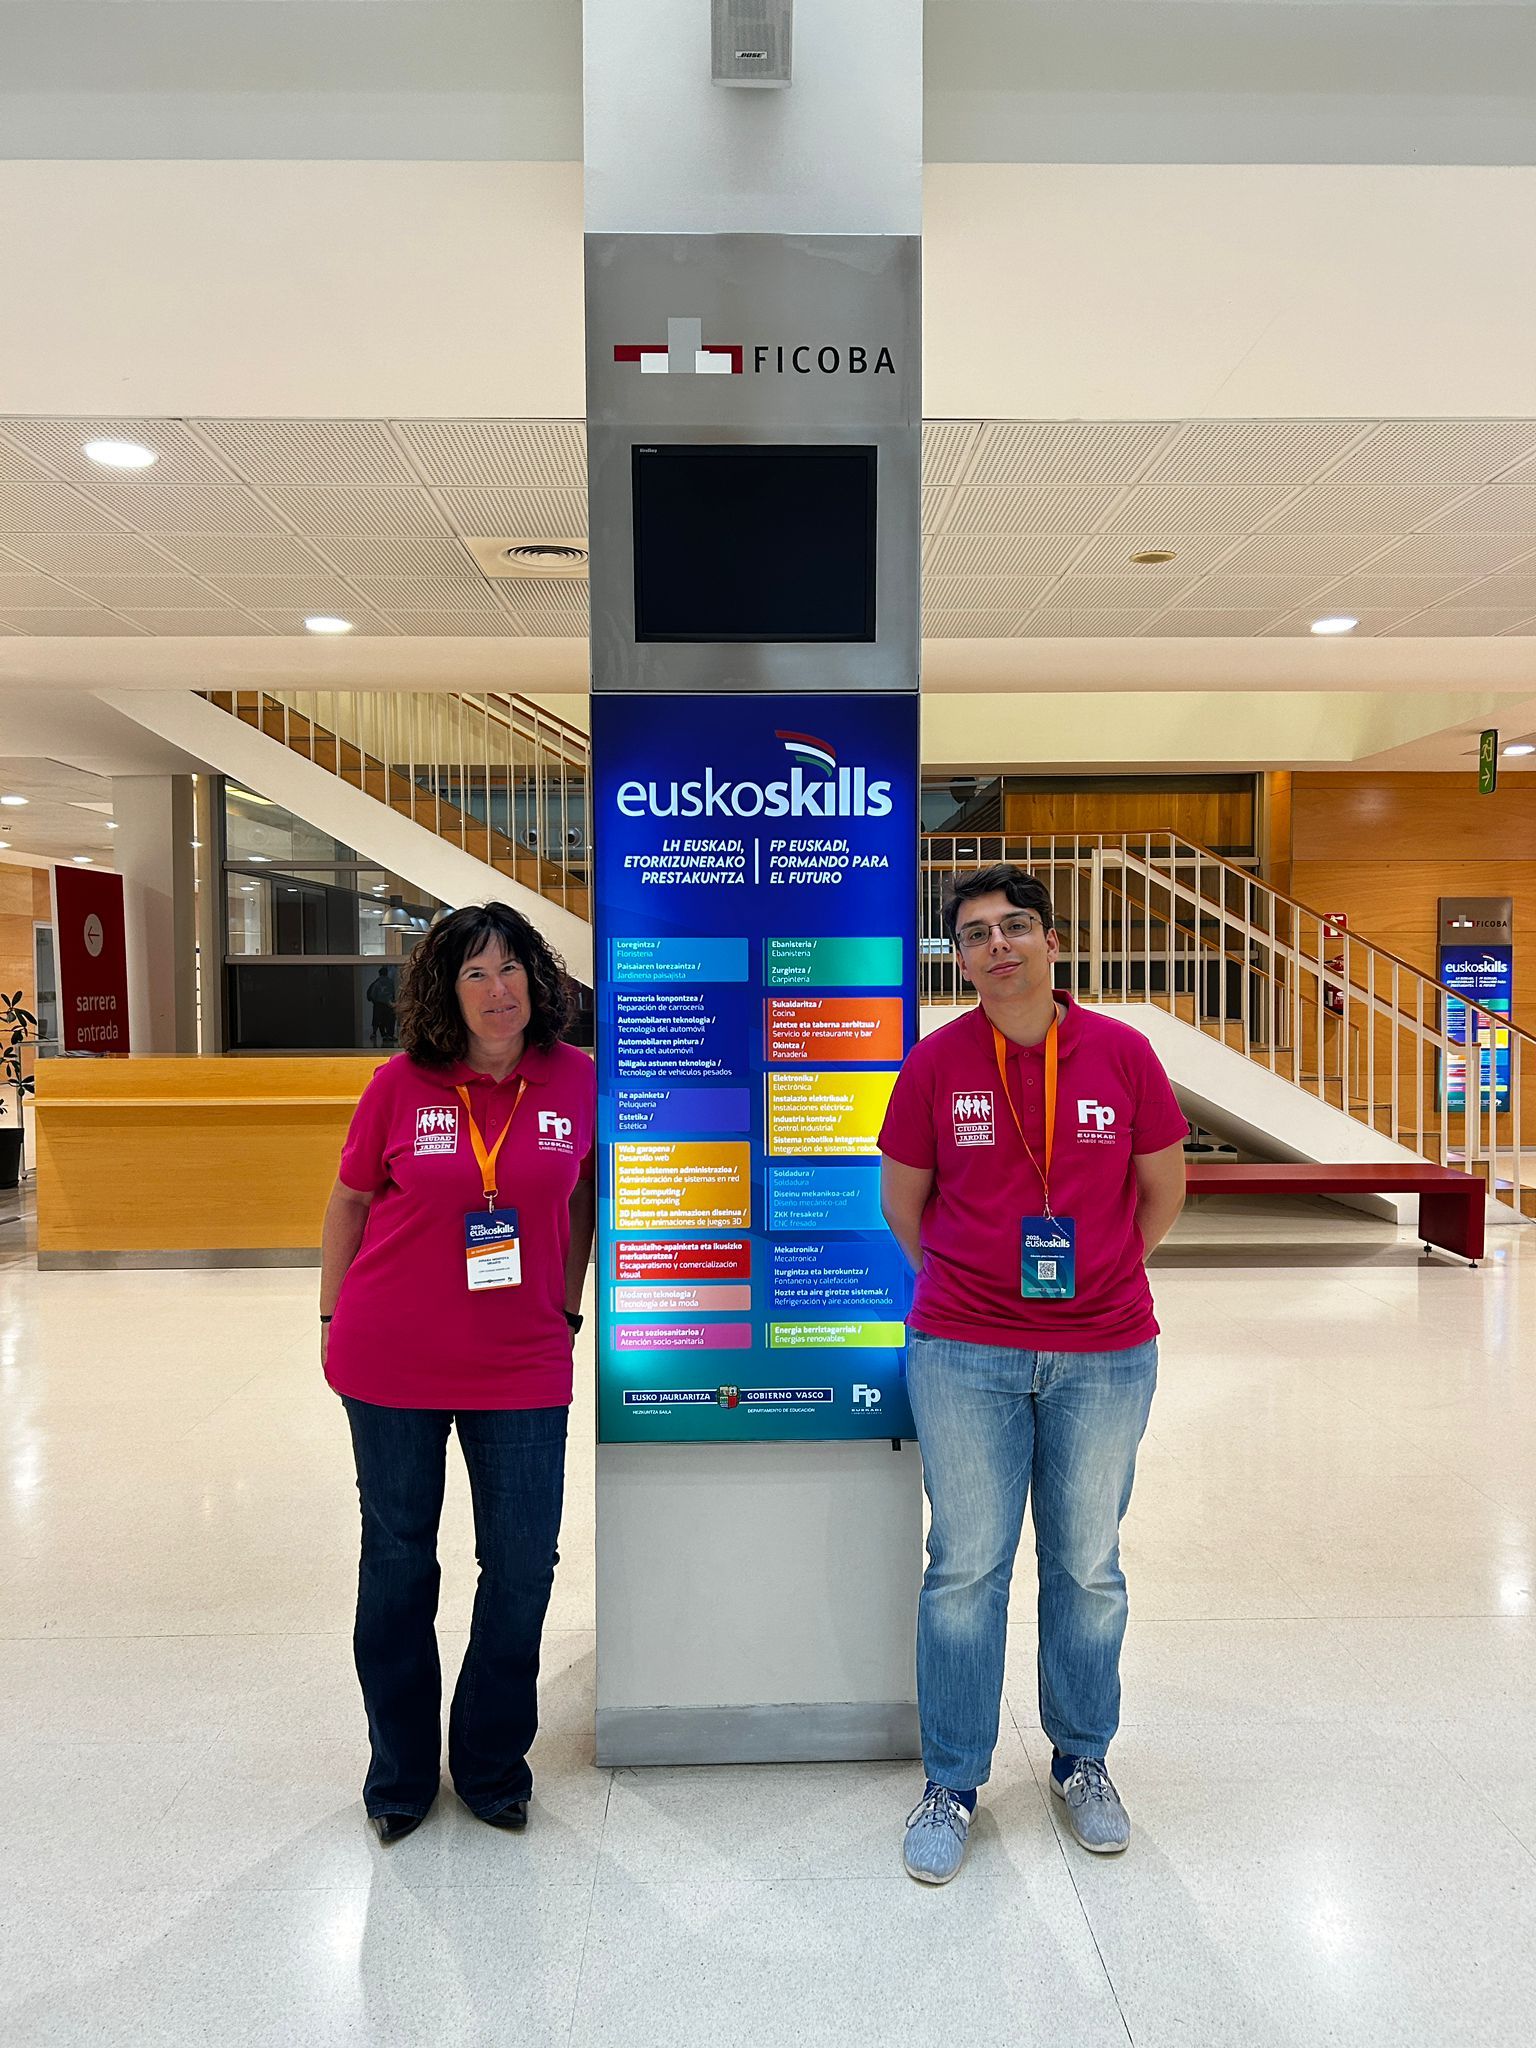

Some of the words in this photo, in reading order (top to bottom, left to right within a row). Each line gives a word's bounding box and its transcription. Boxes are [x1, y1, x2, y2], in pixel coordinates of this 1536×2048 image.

[754, 346, 896, 374] FICOBA
[616, 767, 892, 817] euskoskills
[663, 840, 680, 852] LH
[683, 840, 744, 854] EUSKADI,
[770, 840, 786, 852] FP
[789, 840, 850, 854] EUSKADI,
[624, 856, 745, 868] ETORKIZUNERAKO
[770, 856, 849, 868] FORMANDO
[852, 856, 888, 868] PARA
[642, 872, 745, 884] PRESTAKUNTZA
[770, 872, 785, 884] EL
[788, 872, 842, 884] FUTURO
[1445, 961, 1508, 972] euskoskills
[77, 994, 116, 1012] sarrera
[656, 995, 698, 1003] konpontzea
[618, 1004, 656, 1012] Reparación
[673, 1016, 710, 1025] teknologia
[77, 1019, 118, 1042] entrada
[673, 1038, 699, 1046] pintura
[679, 1060, 716, 1068] teknologia
[629, 1092, 664, 1100] apainketa
[1077, 1100, 1115, 1130] Fp
[538, 1111, 572, 1139] Fp
[538, 1141, 573, 1149] EUSKADI
[774, 1145, 812, 1154] Integración
[641, 1197, 680, 1206] Computing
[707, 1218, 730, 1226] juegos
[470, 1224, 514, 1237] euskoskills
[1025, 1238, 1070, 1247] euskoskills
[774, 1269, 808, 1277] Iturgintza
[654, 1291, 691, 1299] teknologia
[824, 1289, 849, 1297] girotze
[774, 1298, 820, 1306] Refrigeración
[853, 1384, 881, 1407] Fp
